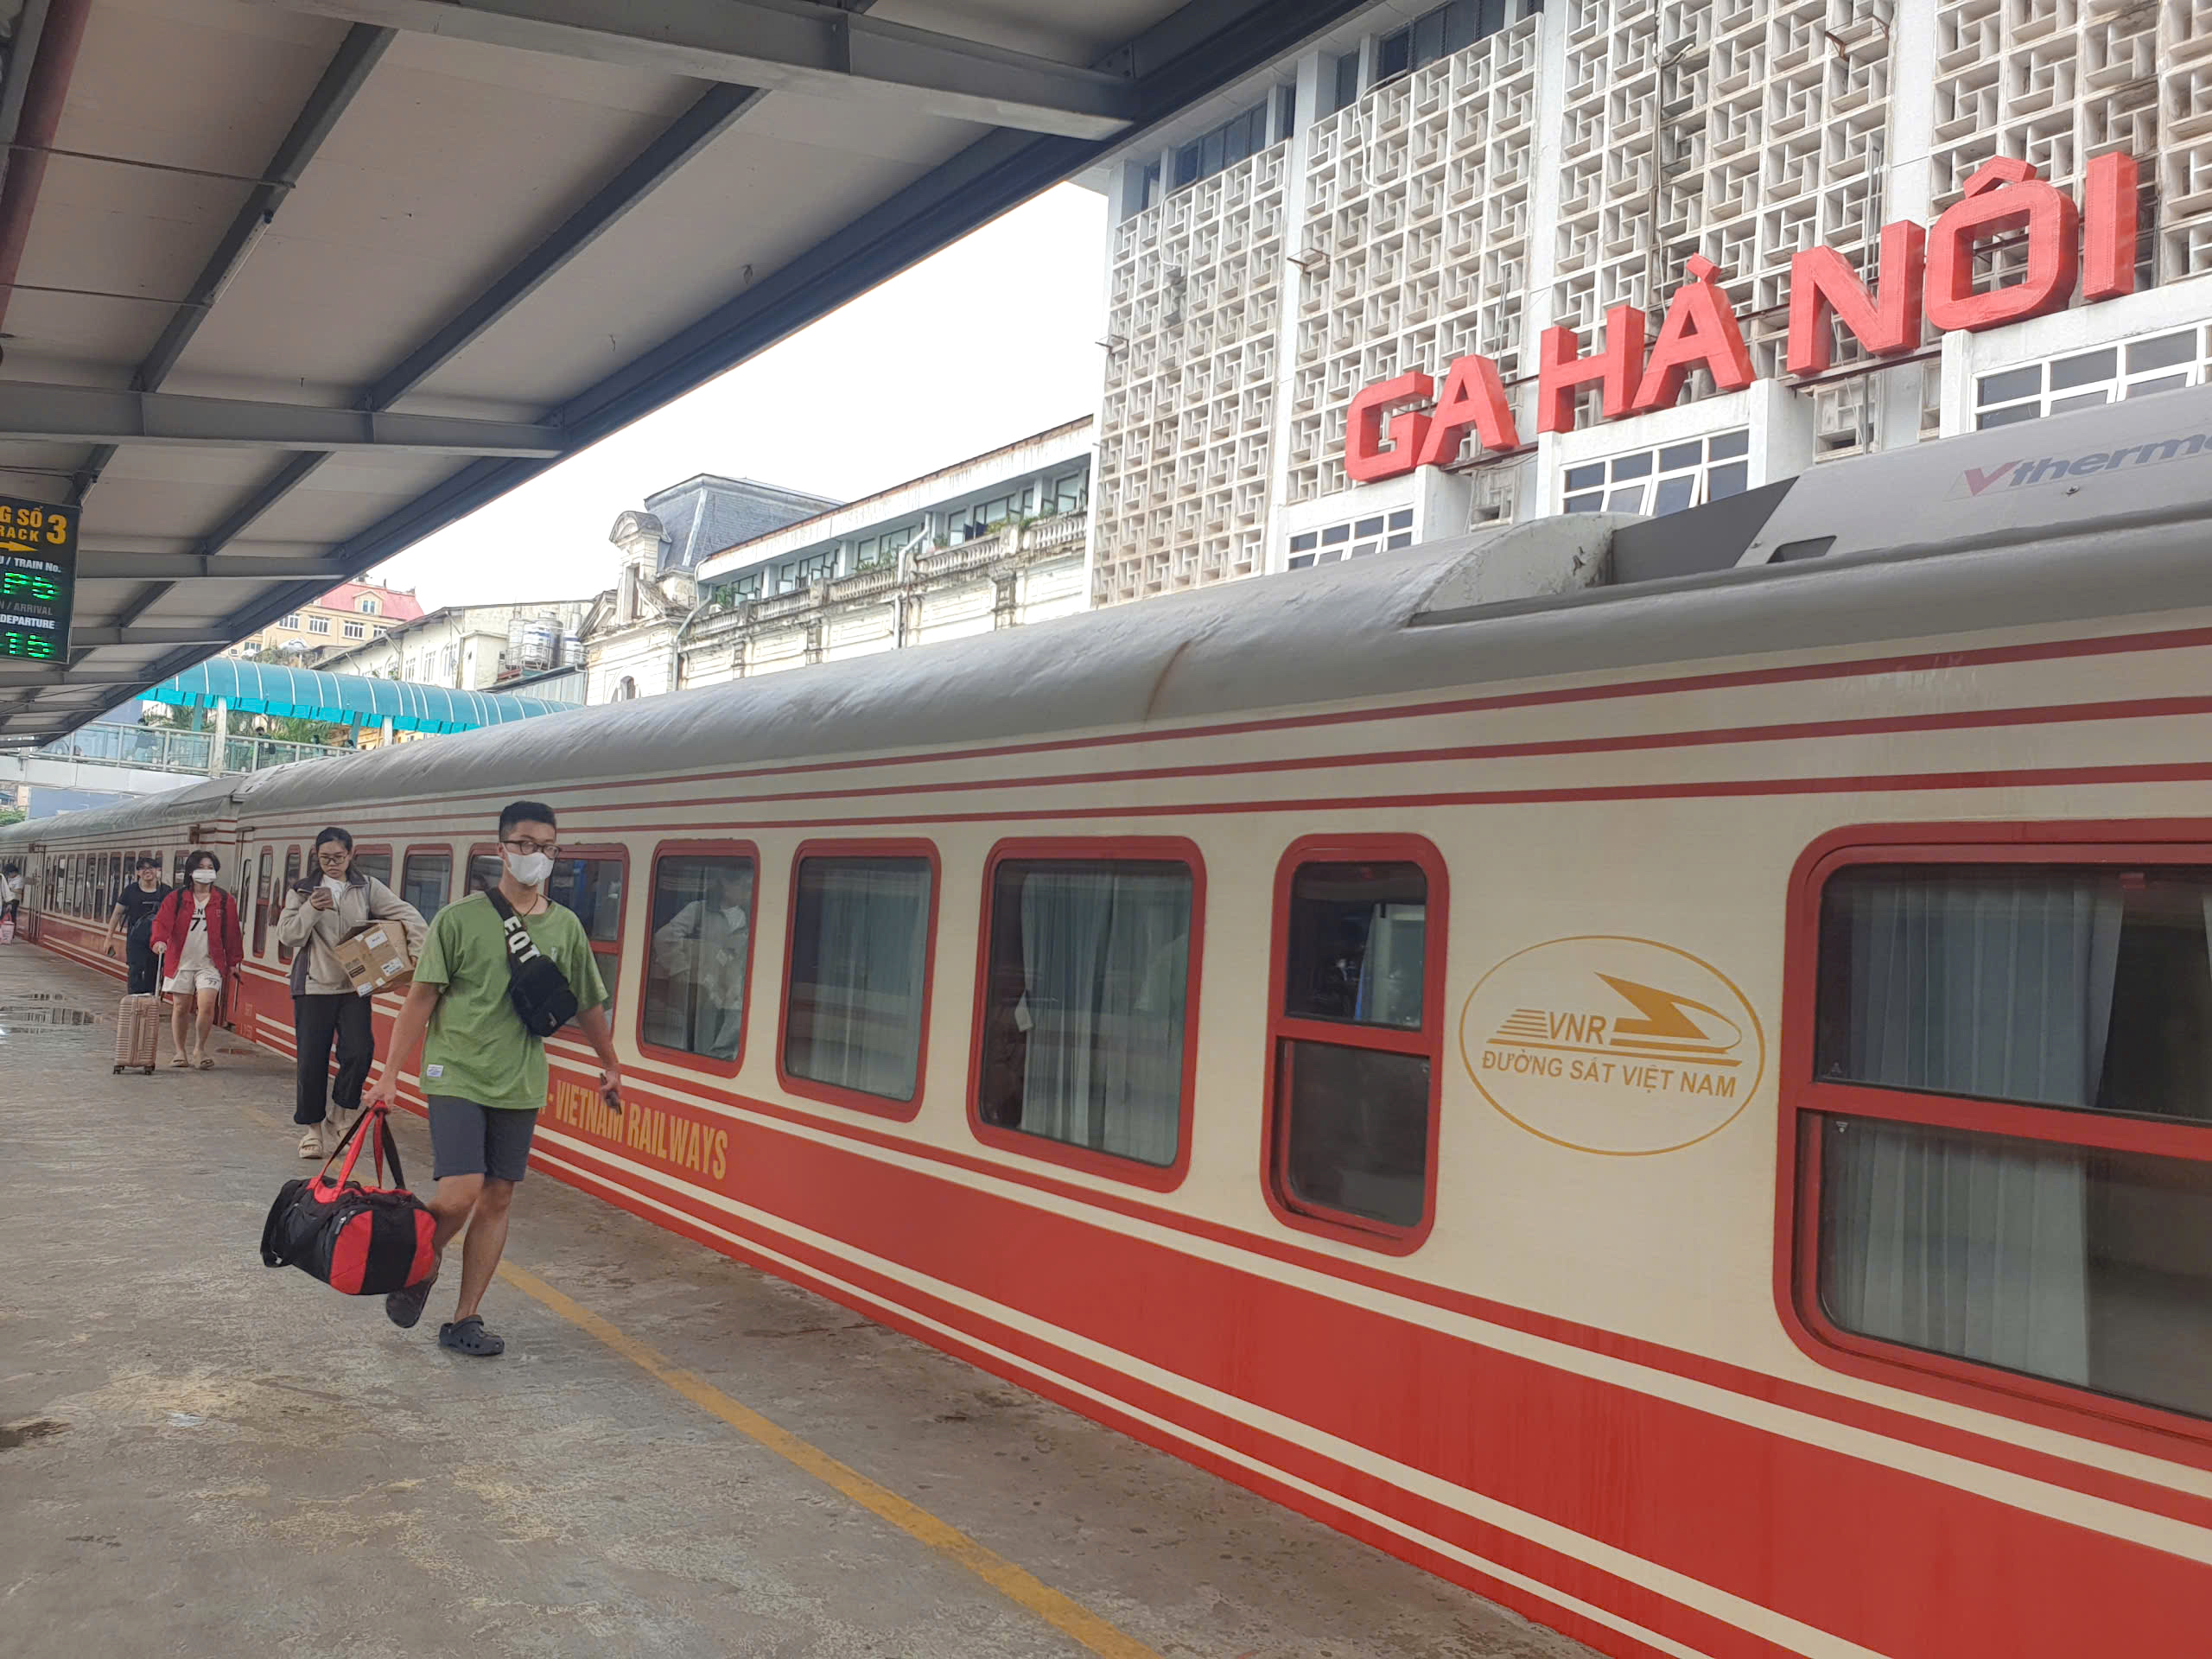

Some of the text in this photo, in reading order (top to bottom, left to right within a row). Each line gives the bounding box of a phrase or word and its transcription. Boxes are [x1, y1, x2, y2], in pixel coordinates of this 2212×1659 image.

[1344, 352, 1522, 483] GA
[1537, 252, 1757, 434] HÀ
[47, 514, 67, 544] 3
[14, 558, 43, 569] TRAIN
[45, 563, 61, 572] No.
[0, 614, 55, 629] DEPARTURE
[14, 603, 54, 616] ARRIVAL
[1549, 1011, 1607, 1045] VNR
[1482, 1048, 1563, 1077] ĐƯỜNG
[1622, 1064, 1675, 1094] VIỆT
[1680, 1071, 1736, 1098] NAM
[556, 1080, 625, 1143] VIETNAM
